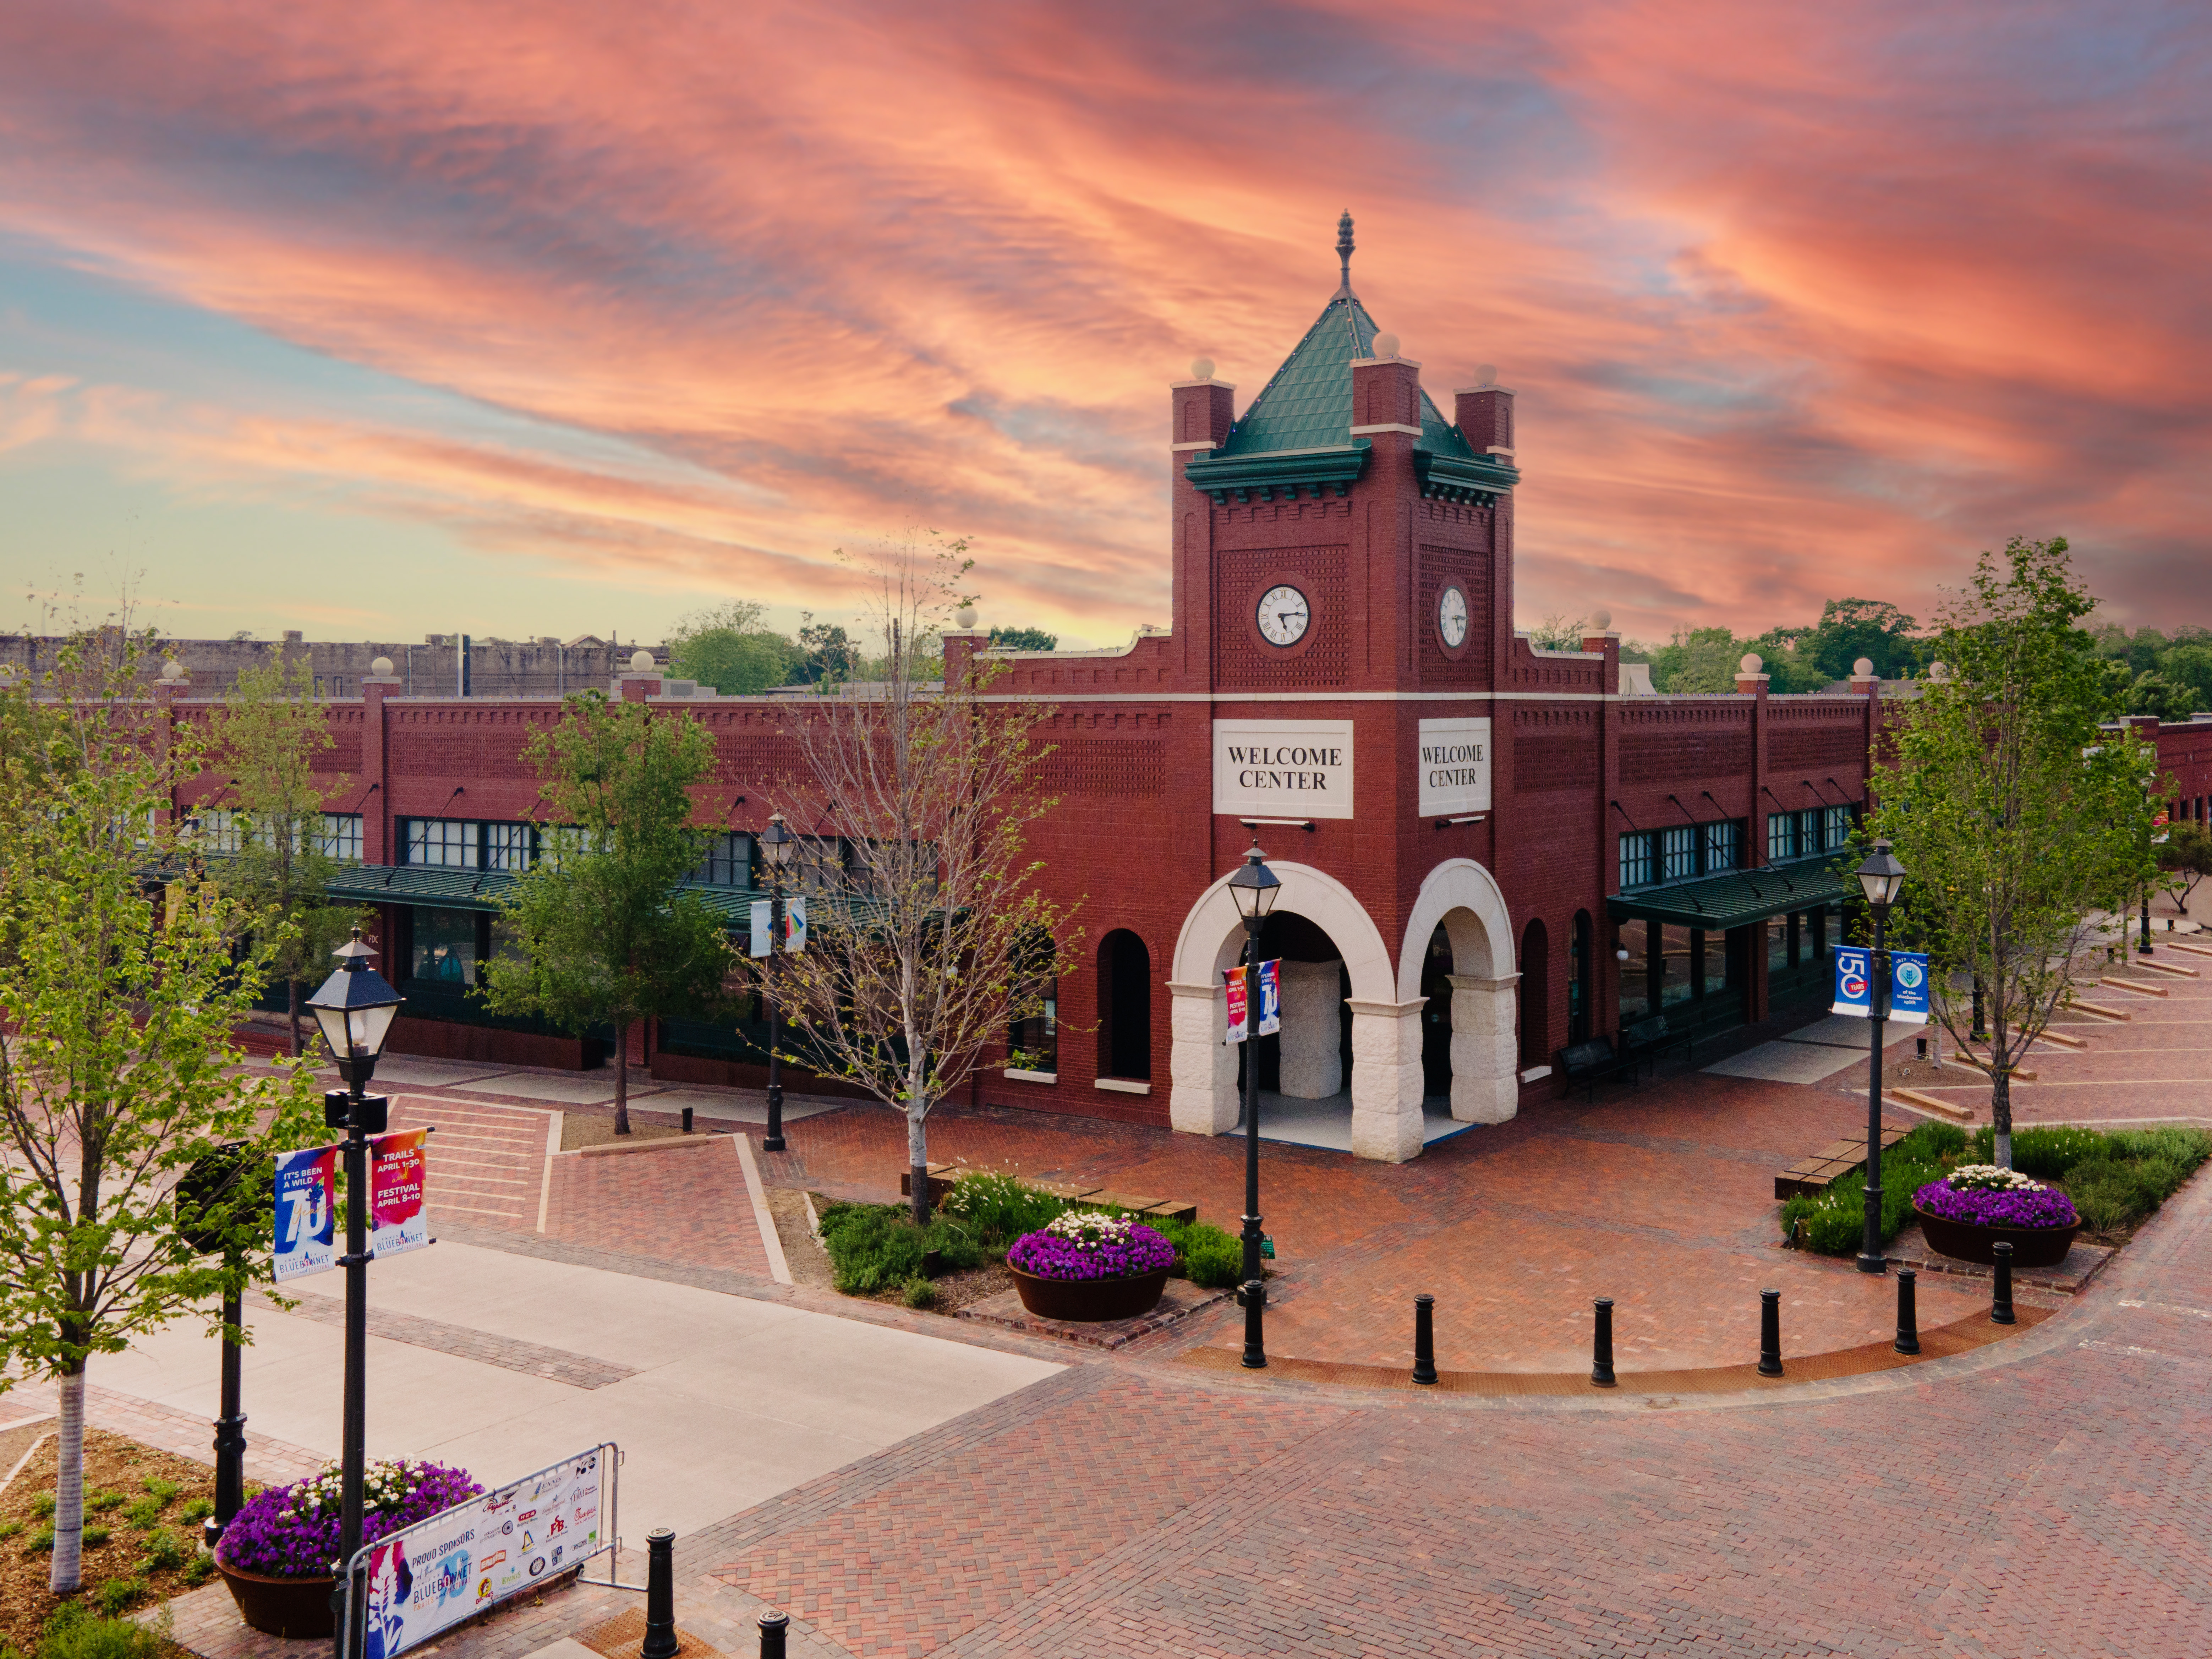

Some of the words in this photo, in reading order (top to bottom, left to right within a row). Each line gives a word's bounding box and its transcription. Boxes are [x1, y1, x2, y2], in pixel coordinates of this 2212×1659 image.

[1228, 747, 1342, 766] WELCOME
[1422, 745, 1483, 764] WELCOME
[1239, 770, 1327, 790] CENTER
[1429, 768, 1476, 787] CENTER
[369, 935, 379, 943] FDC
[1838, 952, 1865, 999] 150
[1230, 1001, 1245, 1009] FESTIVAL
[1262, 984, 1277, 1015] 70
[383, 1149, 415, 1162] TRAILS
[284, 1171, 299, 1180] IT'S
[301, 1167, 322, 1177] BEEN
[377, 1162, 400, 1173] APRIL
[402, 1158, 420, 1168] 1-30
[392, 1165, 408, 1183] and
[292, 1177, 313, 1187] WILD
[378, 1183, 420, 1199] FESTIVAL
[377, 1197, 400, 1208] APRIL
[402, 1193, 421, 1202] 8-10
[283, 1188, 326, 1242] 70
[292, 1203, 331, 1225] Years
[377, 1233, 422, 1251] BLUEBONNET
[280, 1254, 329, 1273] BLUEBONNET
[412, 1548, 436, 1568] PROUD
[439, 1529, 475, 1556] SPONSORS
[414, 1562, 472, 1604] BLUEBONNET
[414, 1596, 434, 1612] TRAILS
[447, 1577, 471, 1595] FESTIVAL
